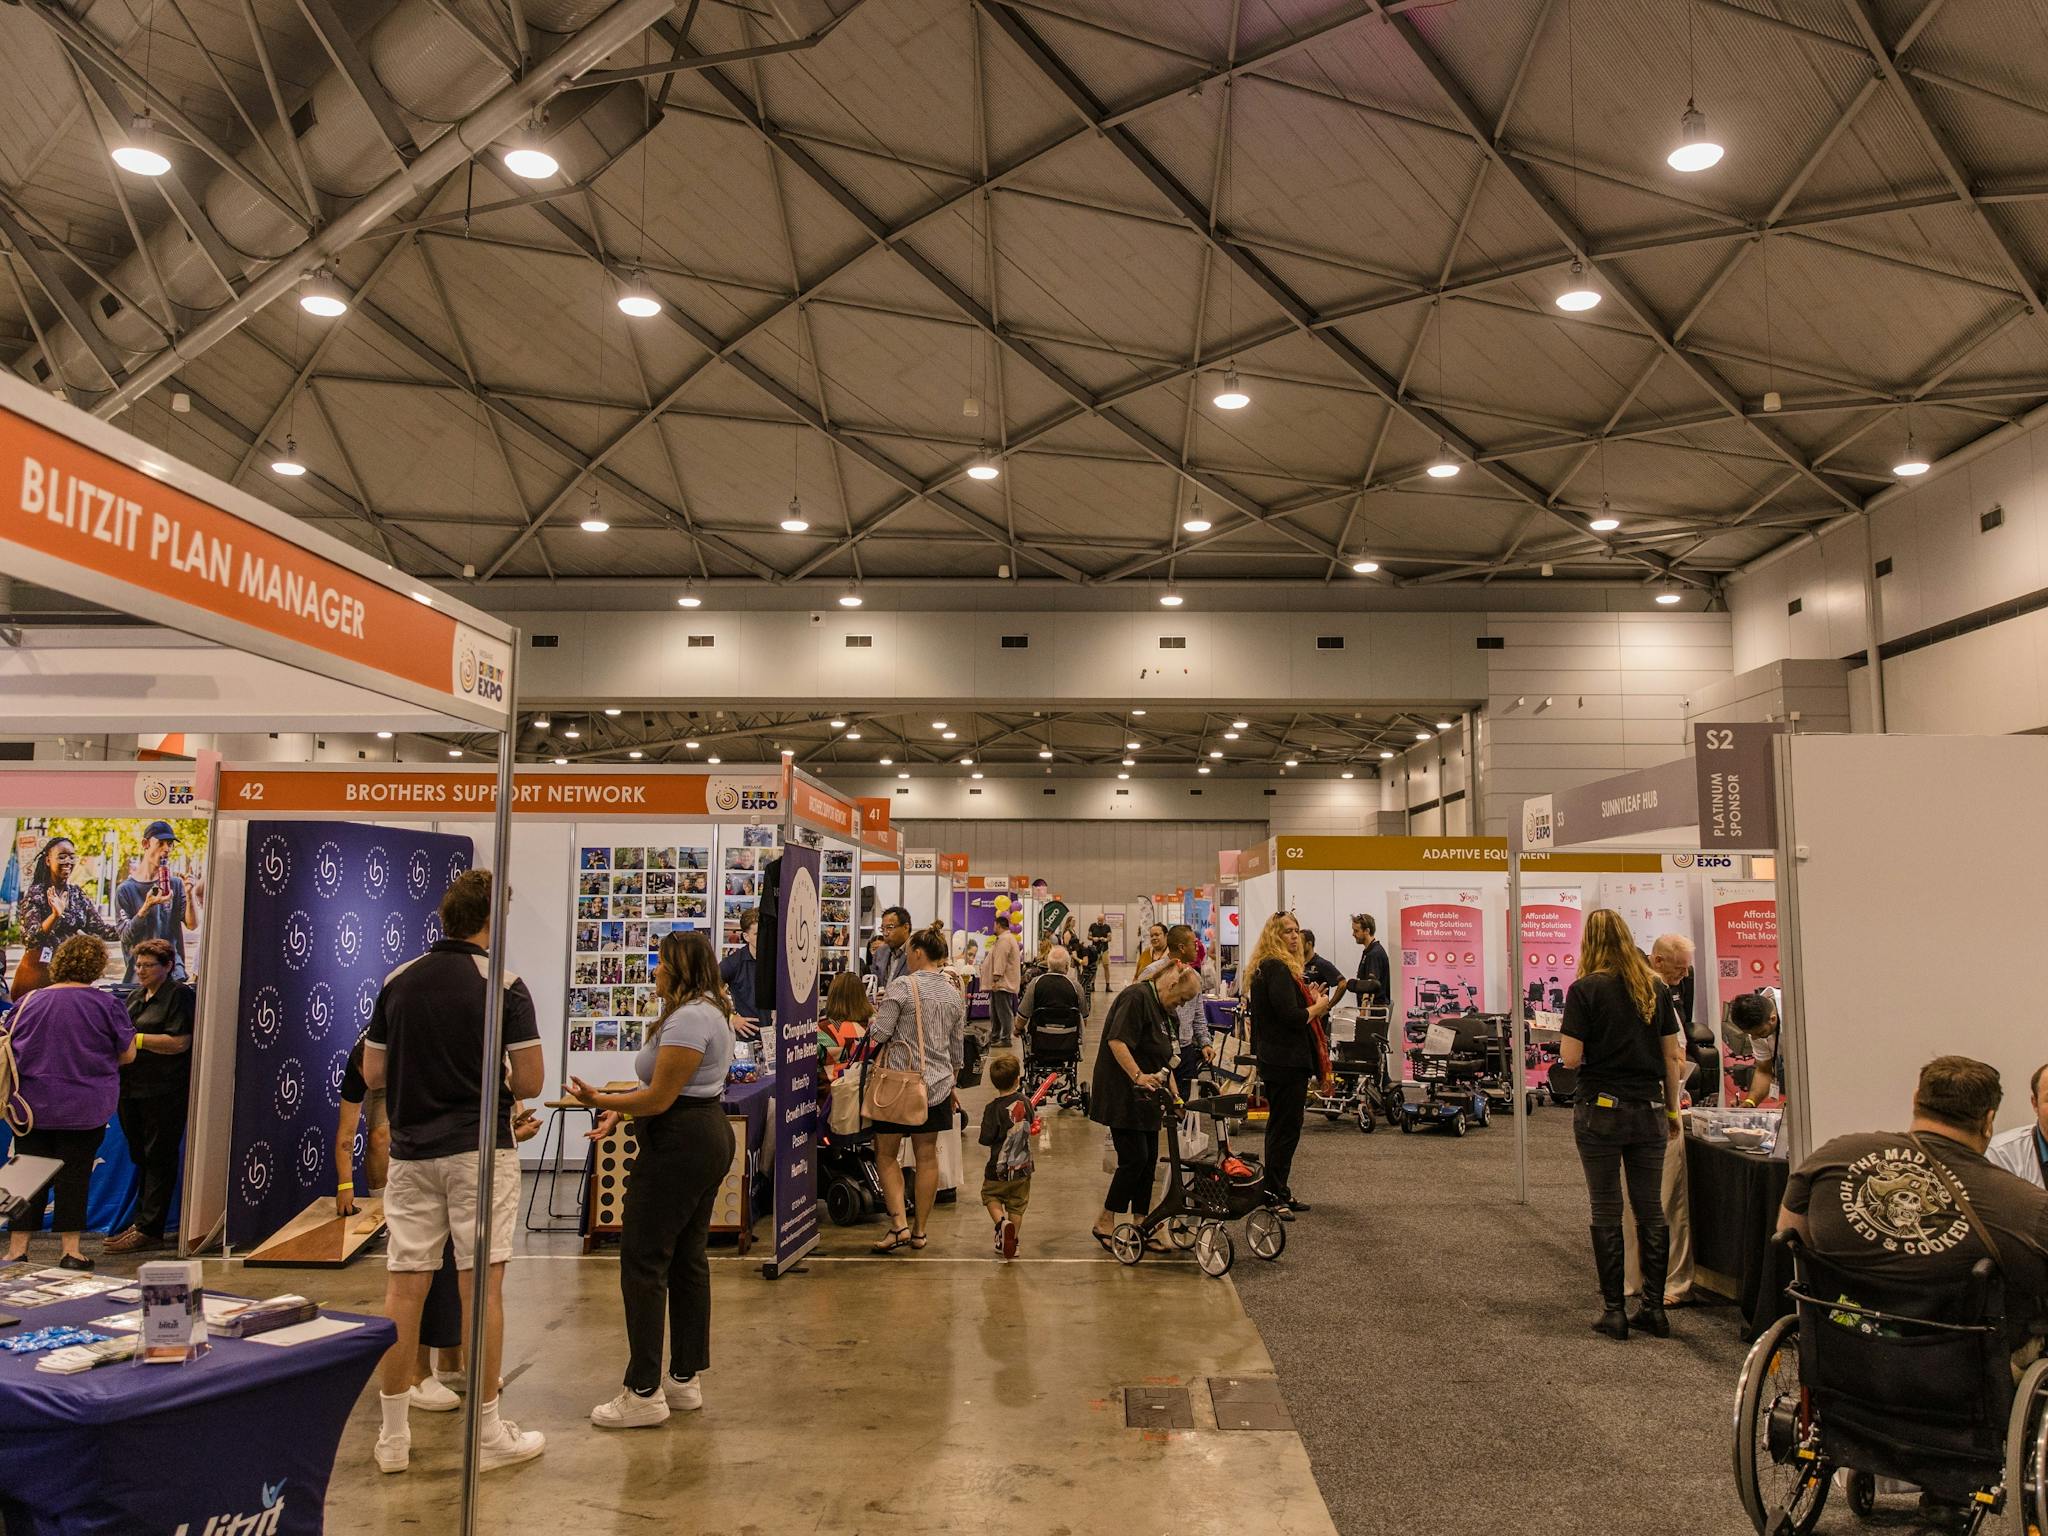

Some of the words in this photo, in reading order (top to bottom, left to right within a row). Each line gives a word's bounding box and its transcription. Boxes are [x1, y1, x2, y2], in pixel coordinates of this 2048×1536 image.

[21, 456, 143, 552] BLITZIT
[151, 512, 232, 587] PLAN
[239, 552, 365, 639] MANAGER
[478, 677, 502, 702] EXPO
[1706, 729, 1734, 749] S2
[169, 794, 194, 804] EXP
[239, 782, 264, 800] 42
[346, 783, 446, 802] BROTHERS
[549, 785, 646, 803] NETWORK
[742, 800, 778, 810] EXPO
[1601, 794, 1642, 818] SUNNYLEAF
[1642, 790, 1658, 809] HUB
[1710, 773, 1725, 836] PLATINUM
[1728, 774, 1742, 837] SPONSOR
[869, 808, 881, 820] 41
[1557, 811, 1565, 827] S3
[1536, 826, 1550, 840] EXPO
[1286, 847, 1304, 859] G2
[1422, 848, 1481, 860] ADAPTIVE
[1484, 848, 1551, 861] EQUMENT
[1697, 859, 1732, 868] EXPO
[1525, 912, 1559, 920] Affordable
[1743, 910, 1776, 919] Afforda
[1727, 921, 1764, 930] Mobility
[1736, 932, 1757, 940] That
[1758, 932, 1777, 940] Mov
[783, 1020, 806, 1041] Changing
[786, 1046, 794, 1064] For
[794, 1044, 803, 1061] The
[792, 1131, 808, 1149] Passion
[1847, 1152, 1881, 1176] THE
[1884, 1148, 1927, 1165] MAD
[1840, 1180, 1878, 1241] HOOKED
[1882, 1238, 1898, 1252] &
[1904, 1220, 1970, 1255] COOKED
